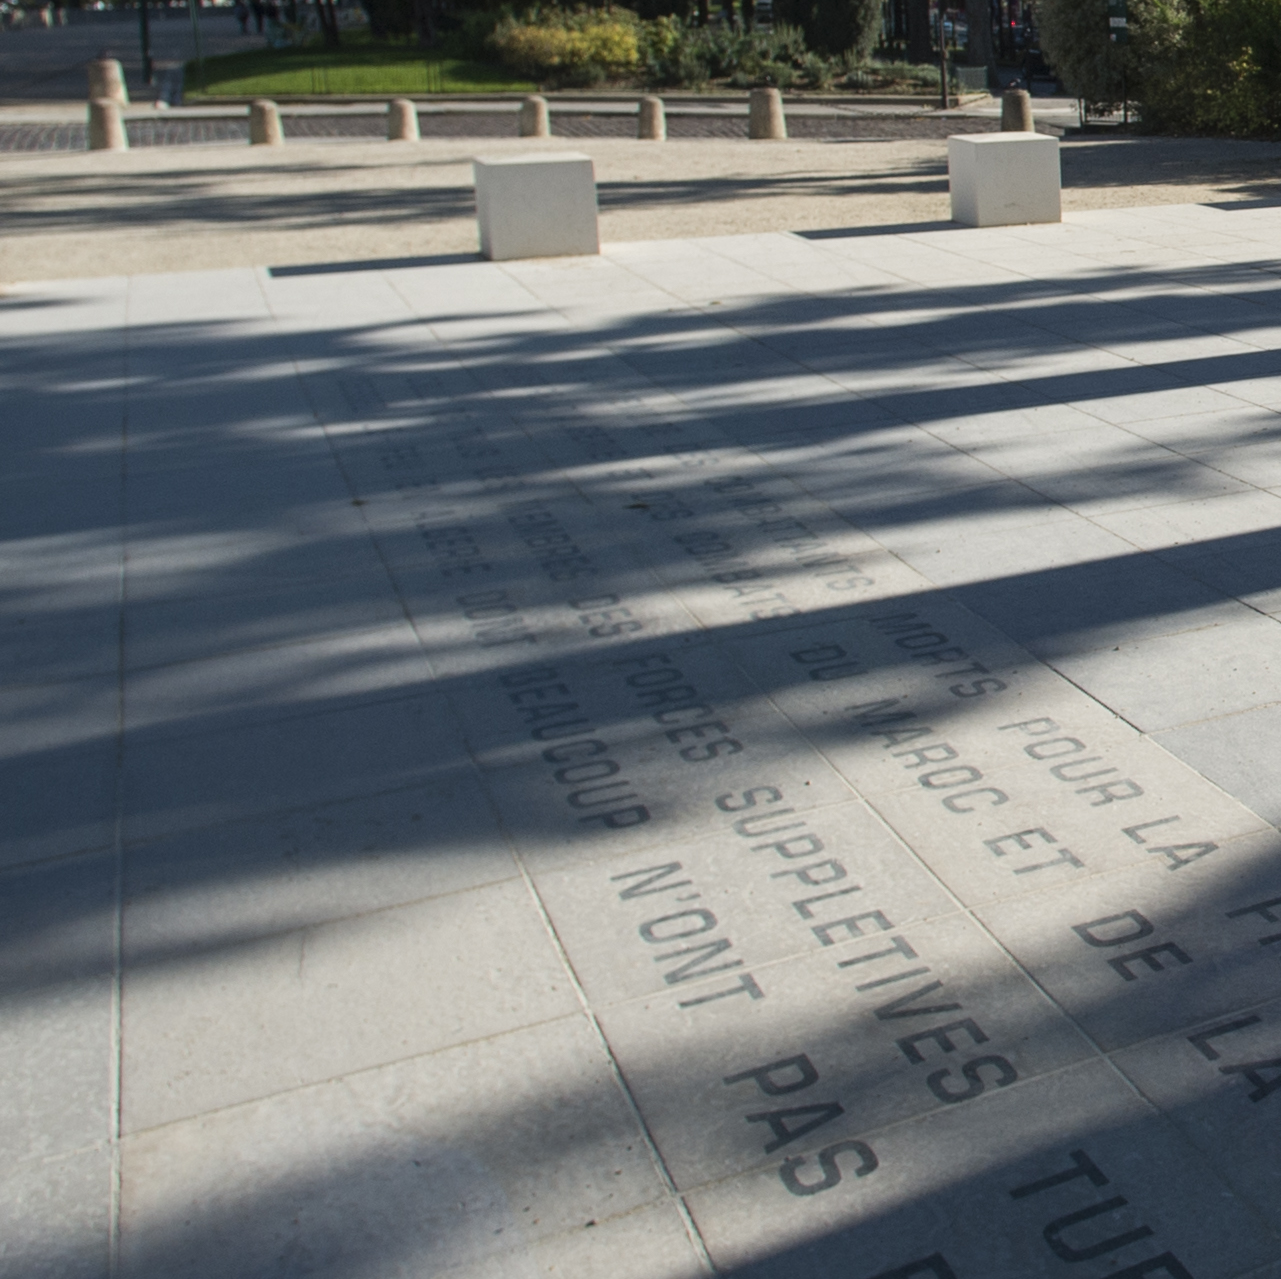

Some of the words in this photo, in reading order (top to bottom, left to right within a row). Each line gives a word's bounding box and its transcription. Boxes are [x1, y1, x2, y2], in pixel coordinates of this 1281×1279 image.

[501, 666, 651, 829] BEAUCOUP
[610, 860, 766, 1010] N'ONT
[722, 1053, 879, 1198] PAS
[568, 594, 643, 639] DES
[610, 653, 744, 764] FORCES
[715, 785, 1018, 1105] SUPPLETIVES
[790, 641, 871, 683] DU
[844, 697, 1010, 815] MAROC
[983, 825, 1086, 876] ET
[1072, 908, 1194, 982] DE
[865, 610, 1008, 700] MORTS
[997, 716, 1144, 807] POUR
[1122, 815, 1219, 871] LA
